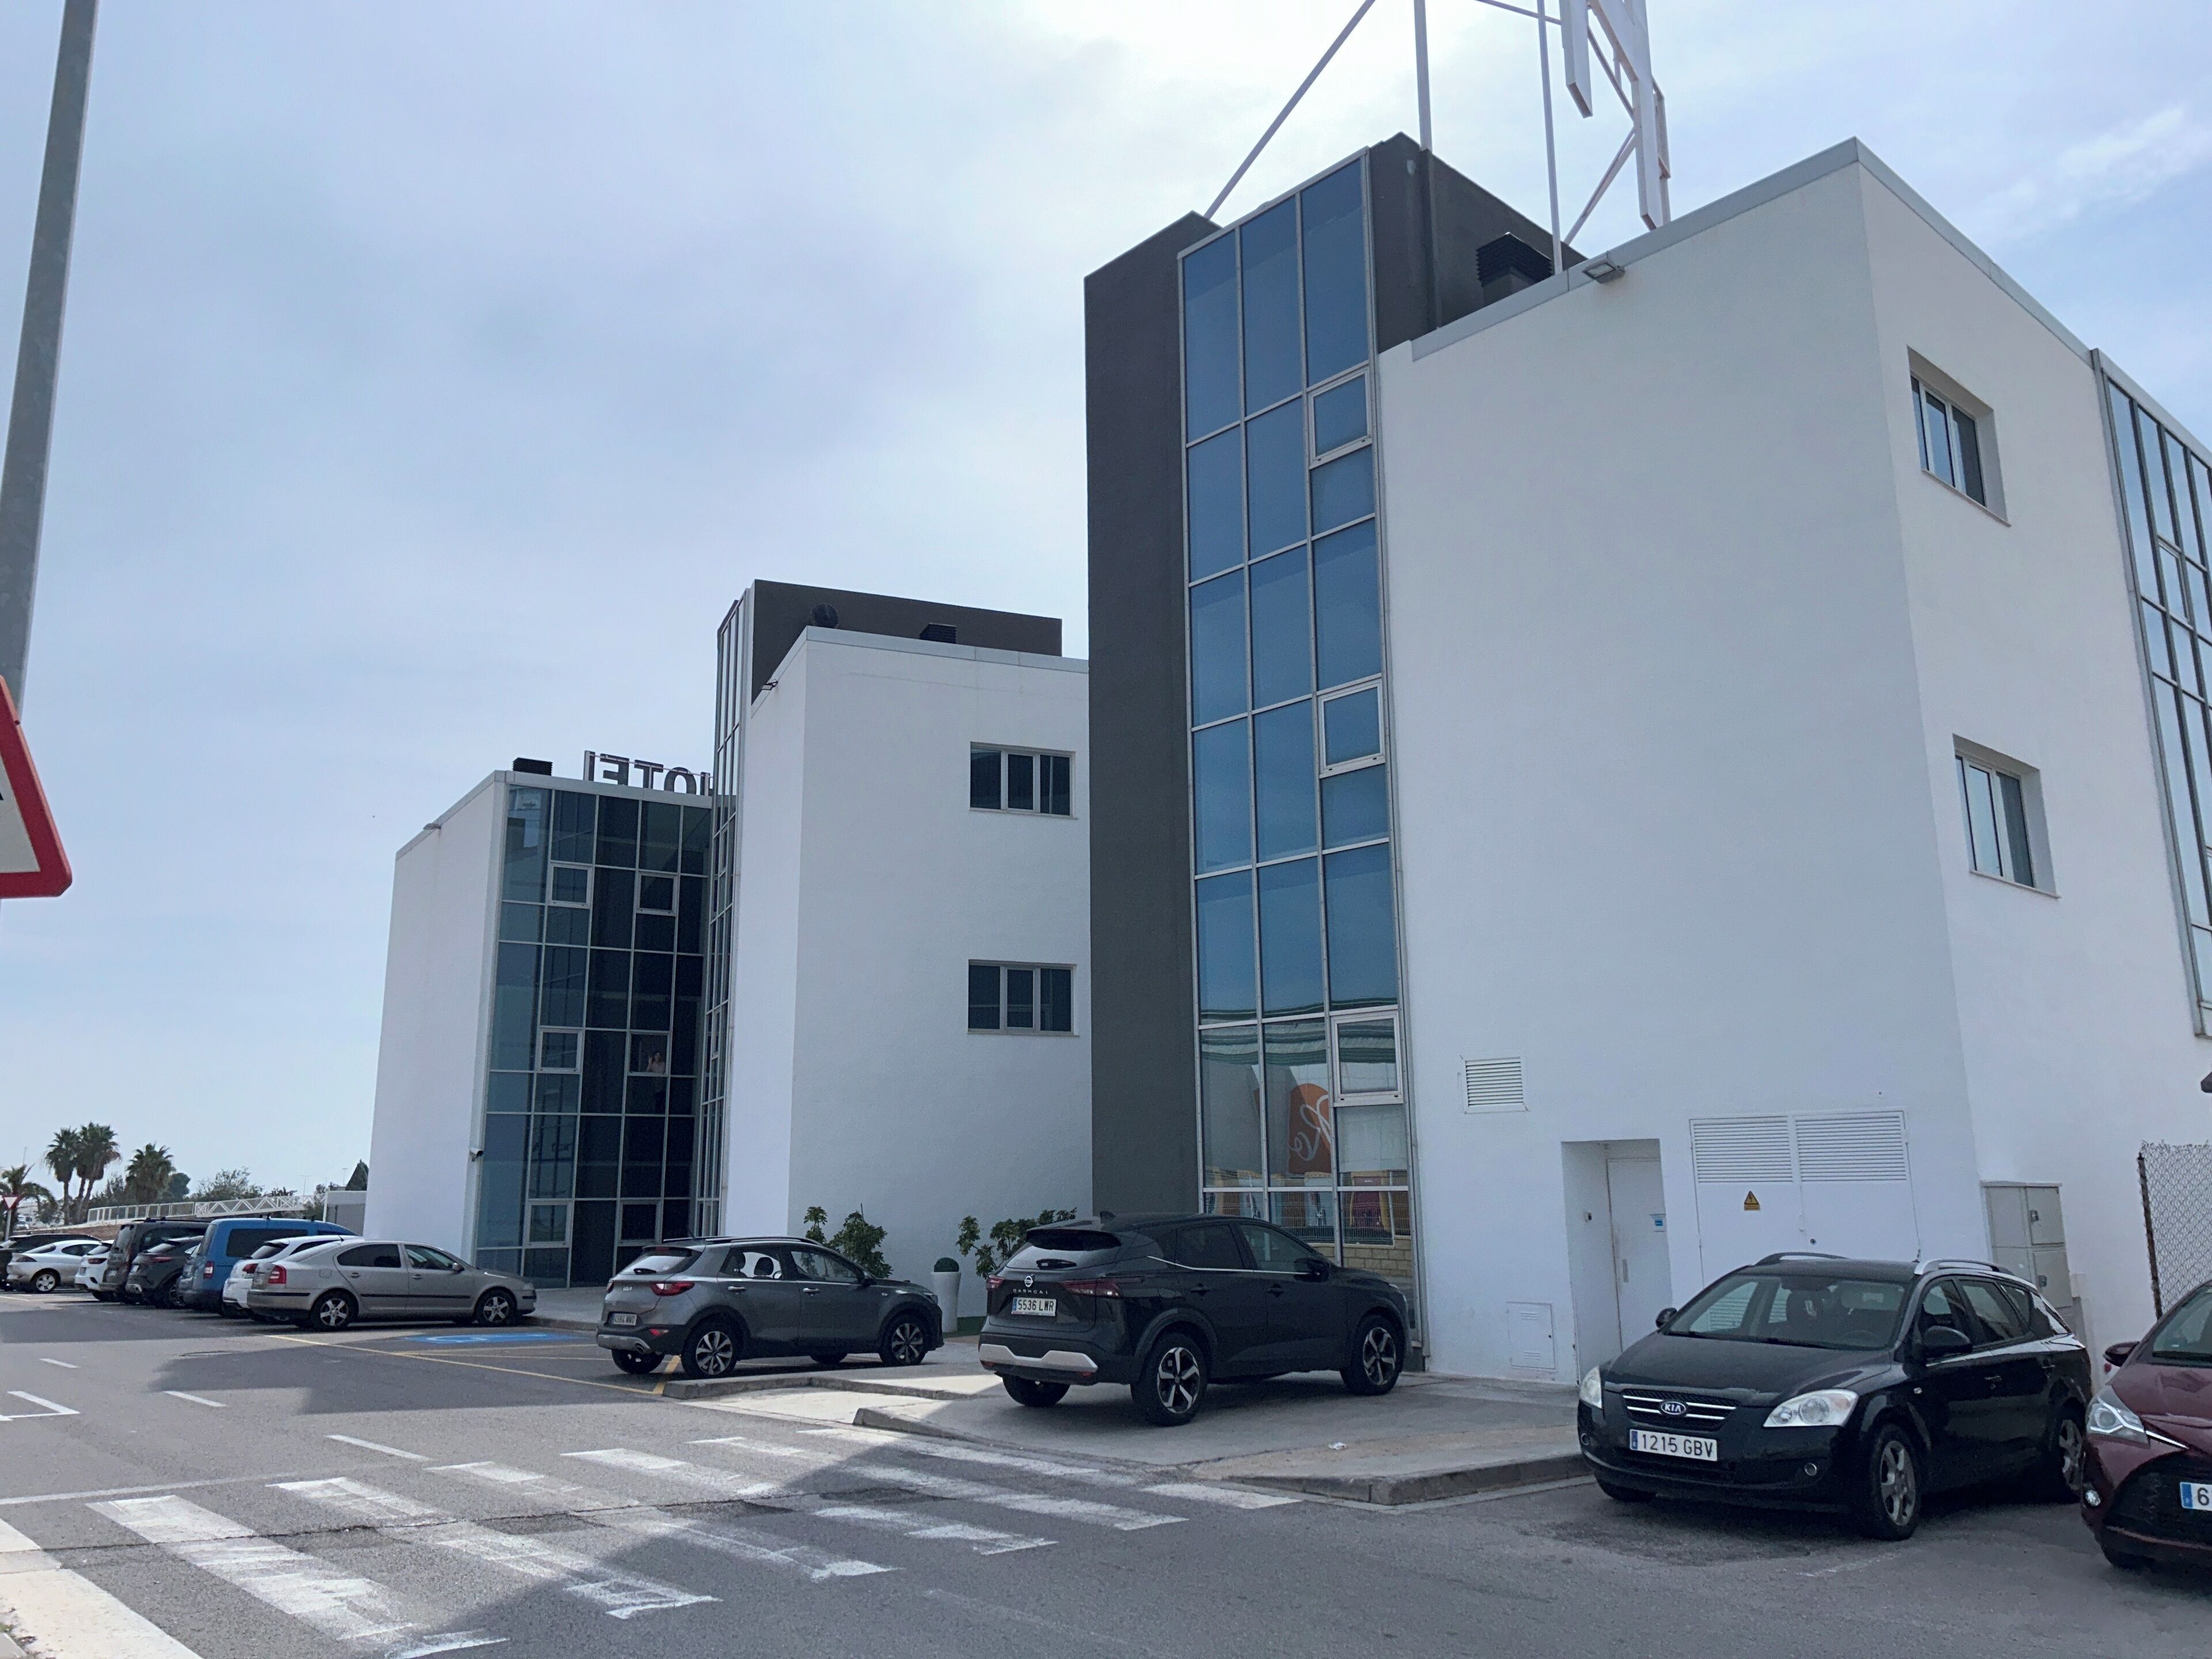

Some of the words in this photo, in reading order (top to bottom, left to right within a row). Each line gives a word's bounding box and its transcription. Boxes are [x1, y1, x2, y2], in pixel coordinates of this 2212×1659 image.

[1018, 1299, 1037, 1310] 5536
[1664, 1403, 1681, 1414] KIA
[1642, 1434, 1677, 1453] 1215
[1683, 1439, 1713, 1458] GBV
[2197, 1487, 2212, 1506] 6
